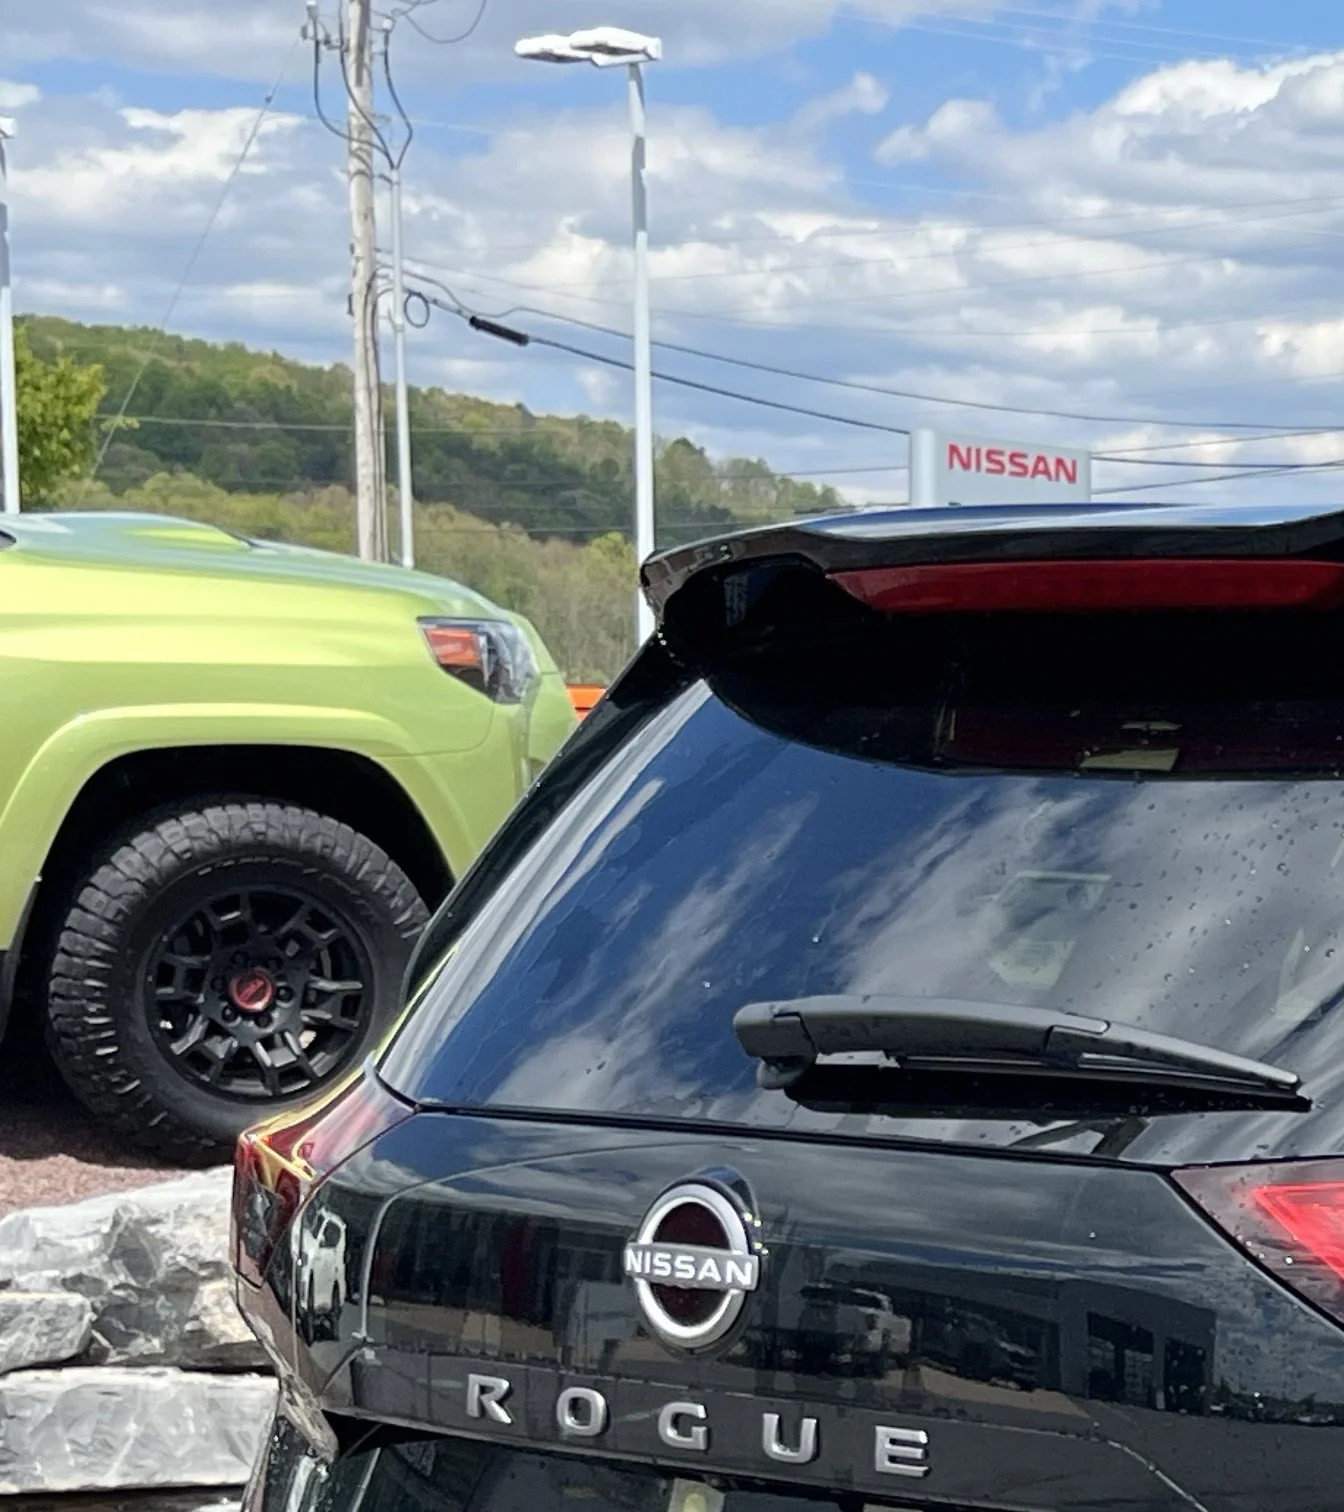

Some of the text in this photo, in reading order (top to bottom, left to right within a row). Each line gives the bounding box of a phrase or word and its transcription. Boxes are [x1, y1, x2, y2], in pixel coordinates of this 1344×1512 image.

[947, 442, 1078, 485] NISSAN
[625, 1248, 753, 1286] NISSAN
[466, 1372, 930, 1478] ROGUE
